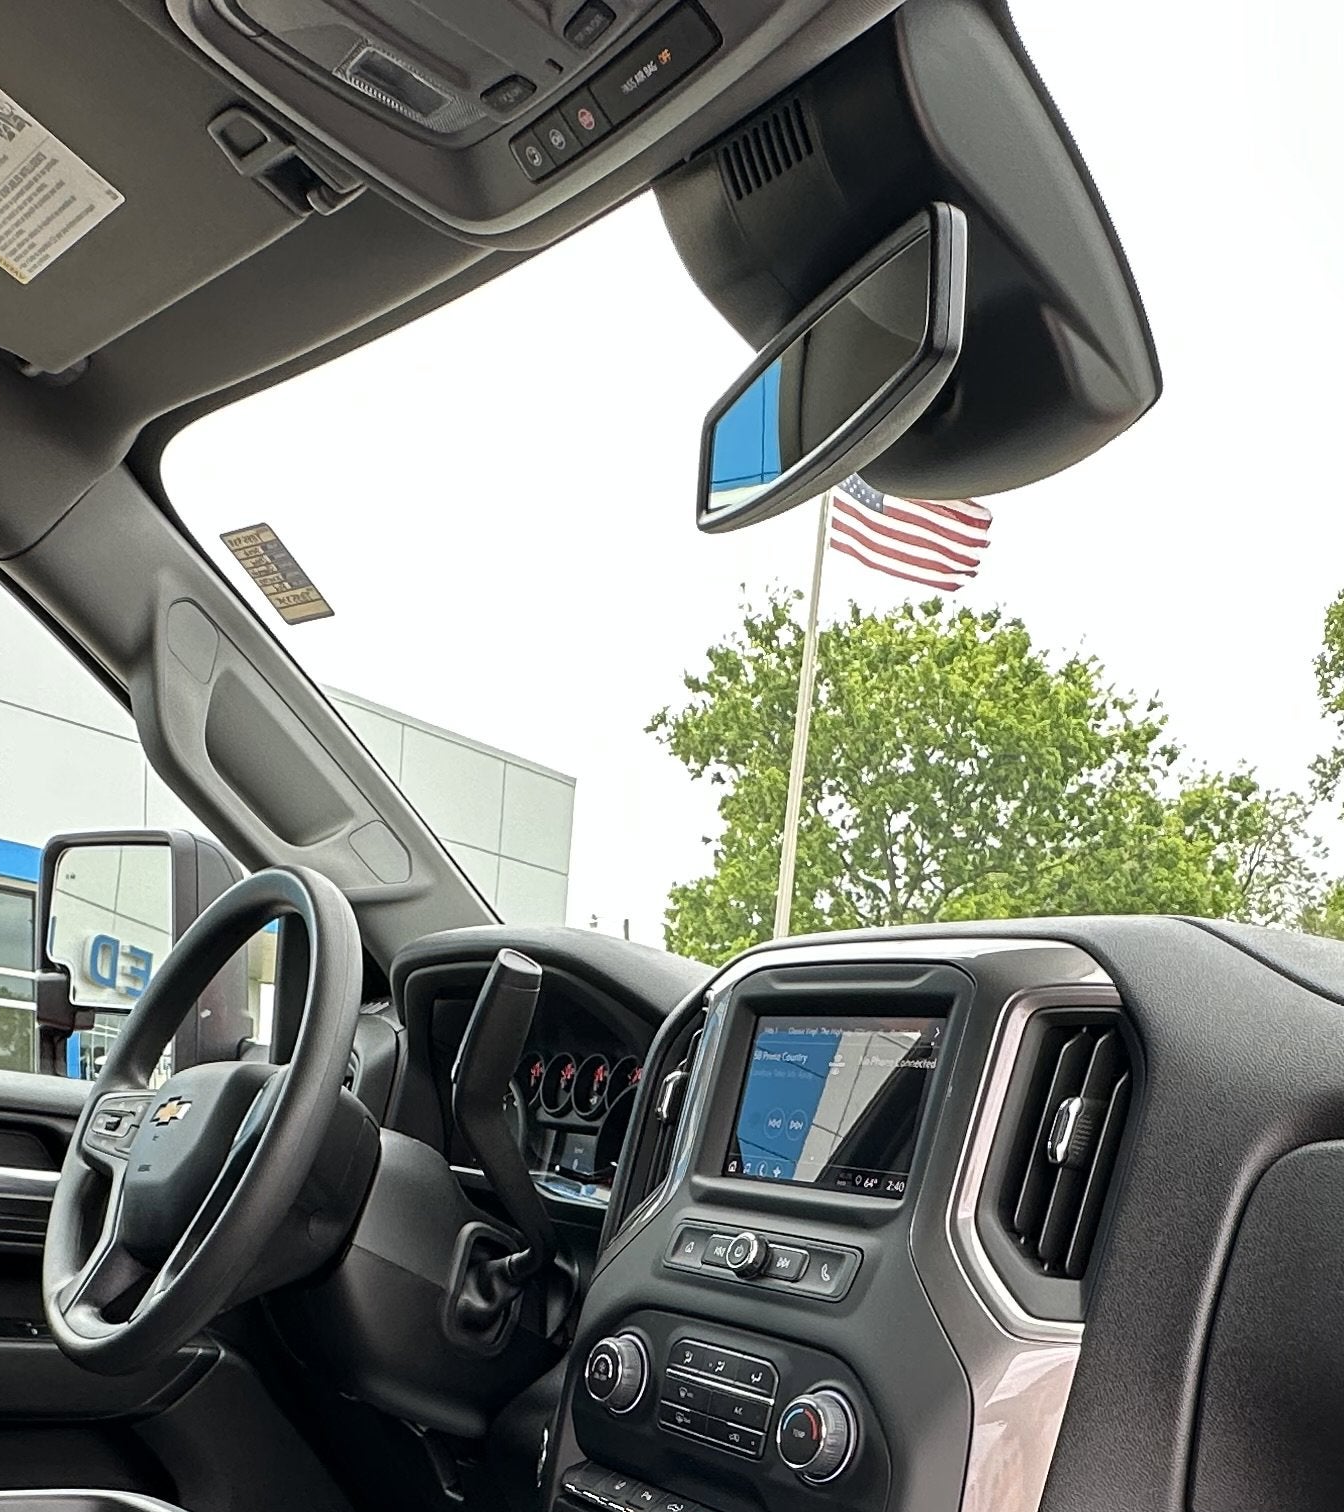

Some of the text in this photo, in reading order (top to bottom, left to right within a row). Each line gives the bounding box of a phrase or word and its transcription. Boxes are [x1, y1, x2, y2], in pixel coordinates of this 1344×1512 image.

[782, 1051, 808, 1065] Country
[895, 1058, 937, 1069] Connected
[886, 1181, 905, 1192] 2:40
